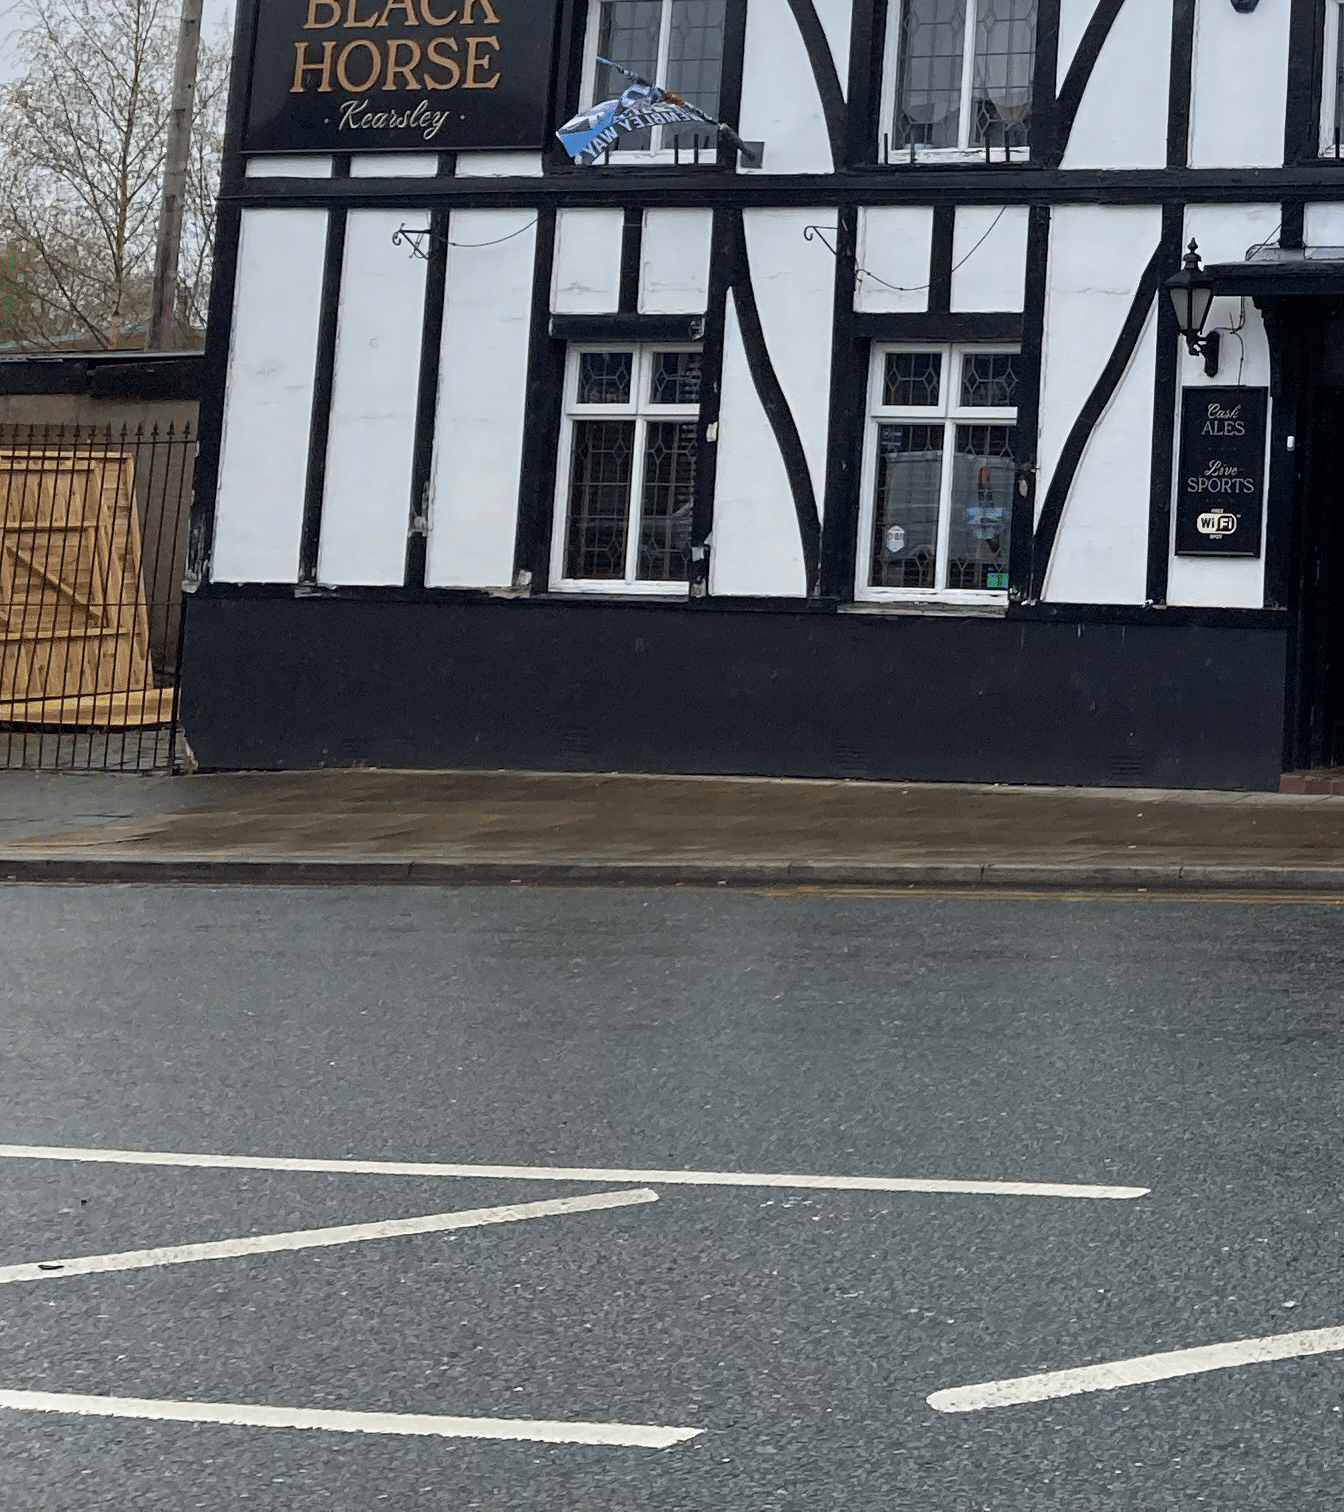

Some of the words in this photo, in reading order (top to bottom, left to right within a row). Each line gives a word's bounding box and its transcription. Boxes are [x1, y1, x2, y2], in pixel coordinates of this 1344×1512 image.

[289, 35, 501, 93] HORSE
[339, 99, 450, 140] Kearsley
[1207, 403, 1242, 419] Cask
[1201, 421, 1245, 436] ALES
[1204, 459, 1239, 477] Live
[1187, 477, 1255, 494] SPORTS
